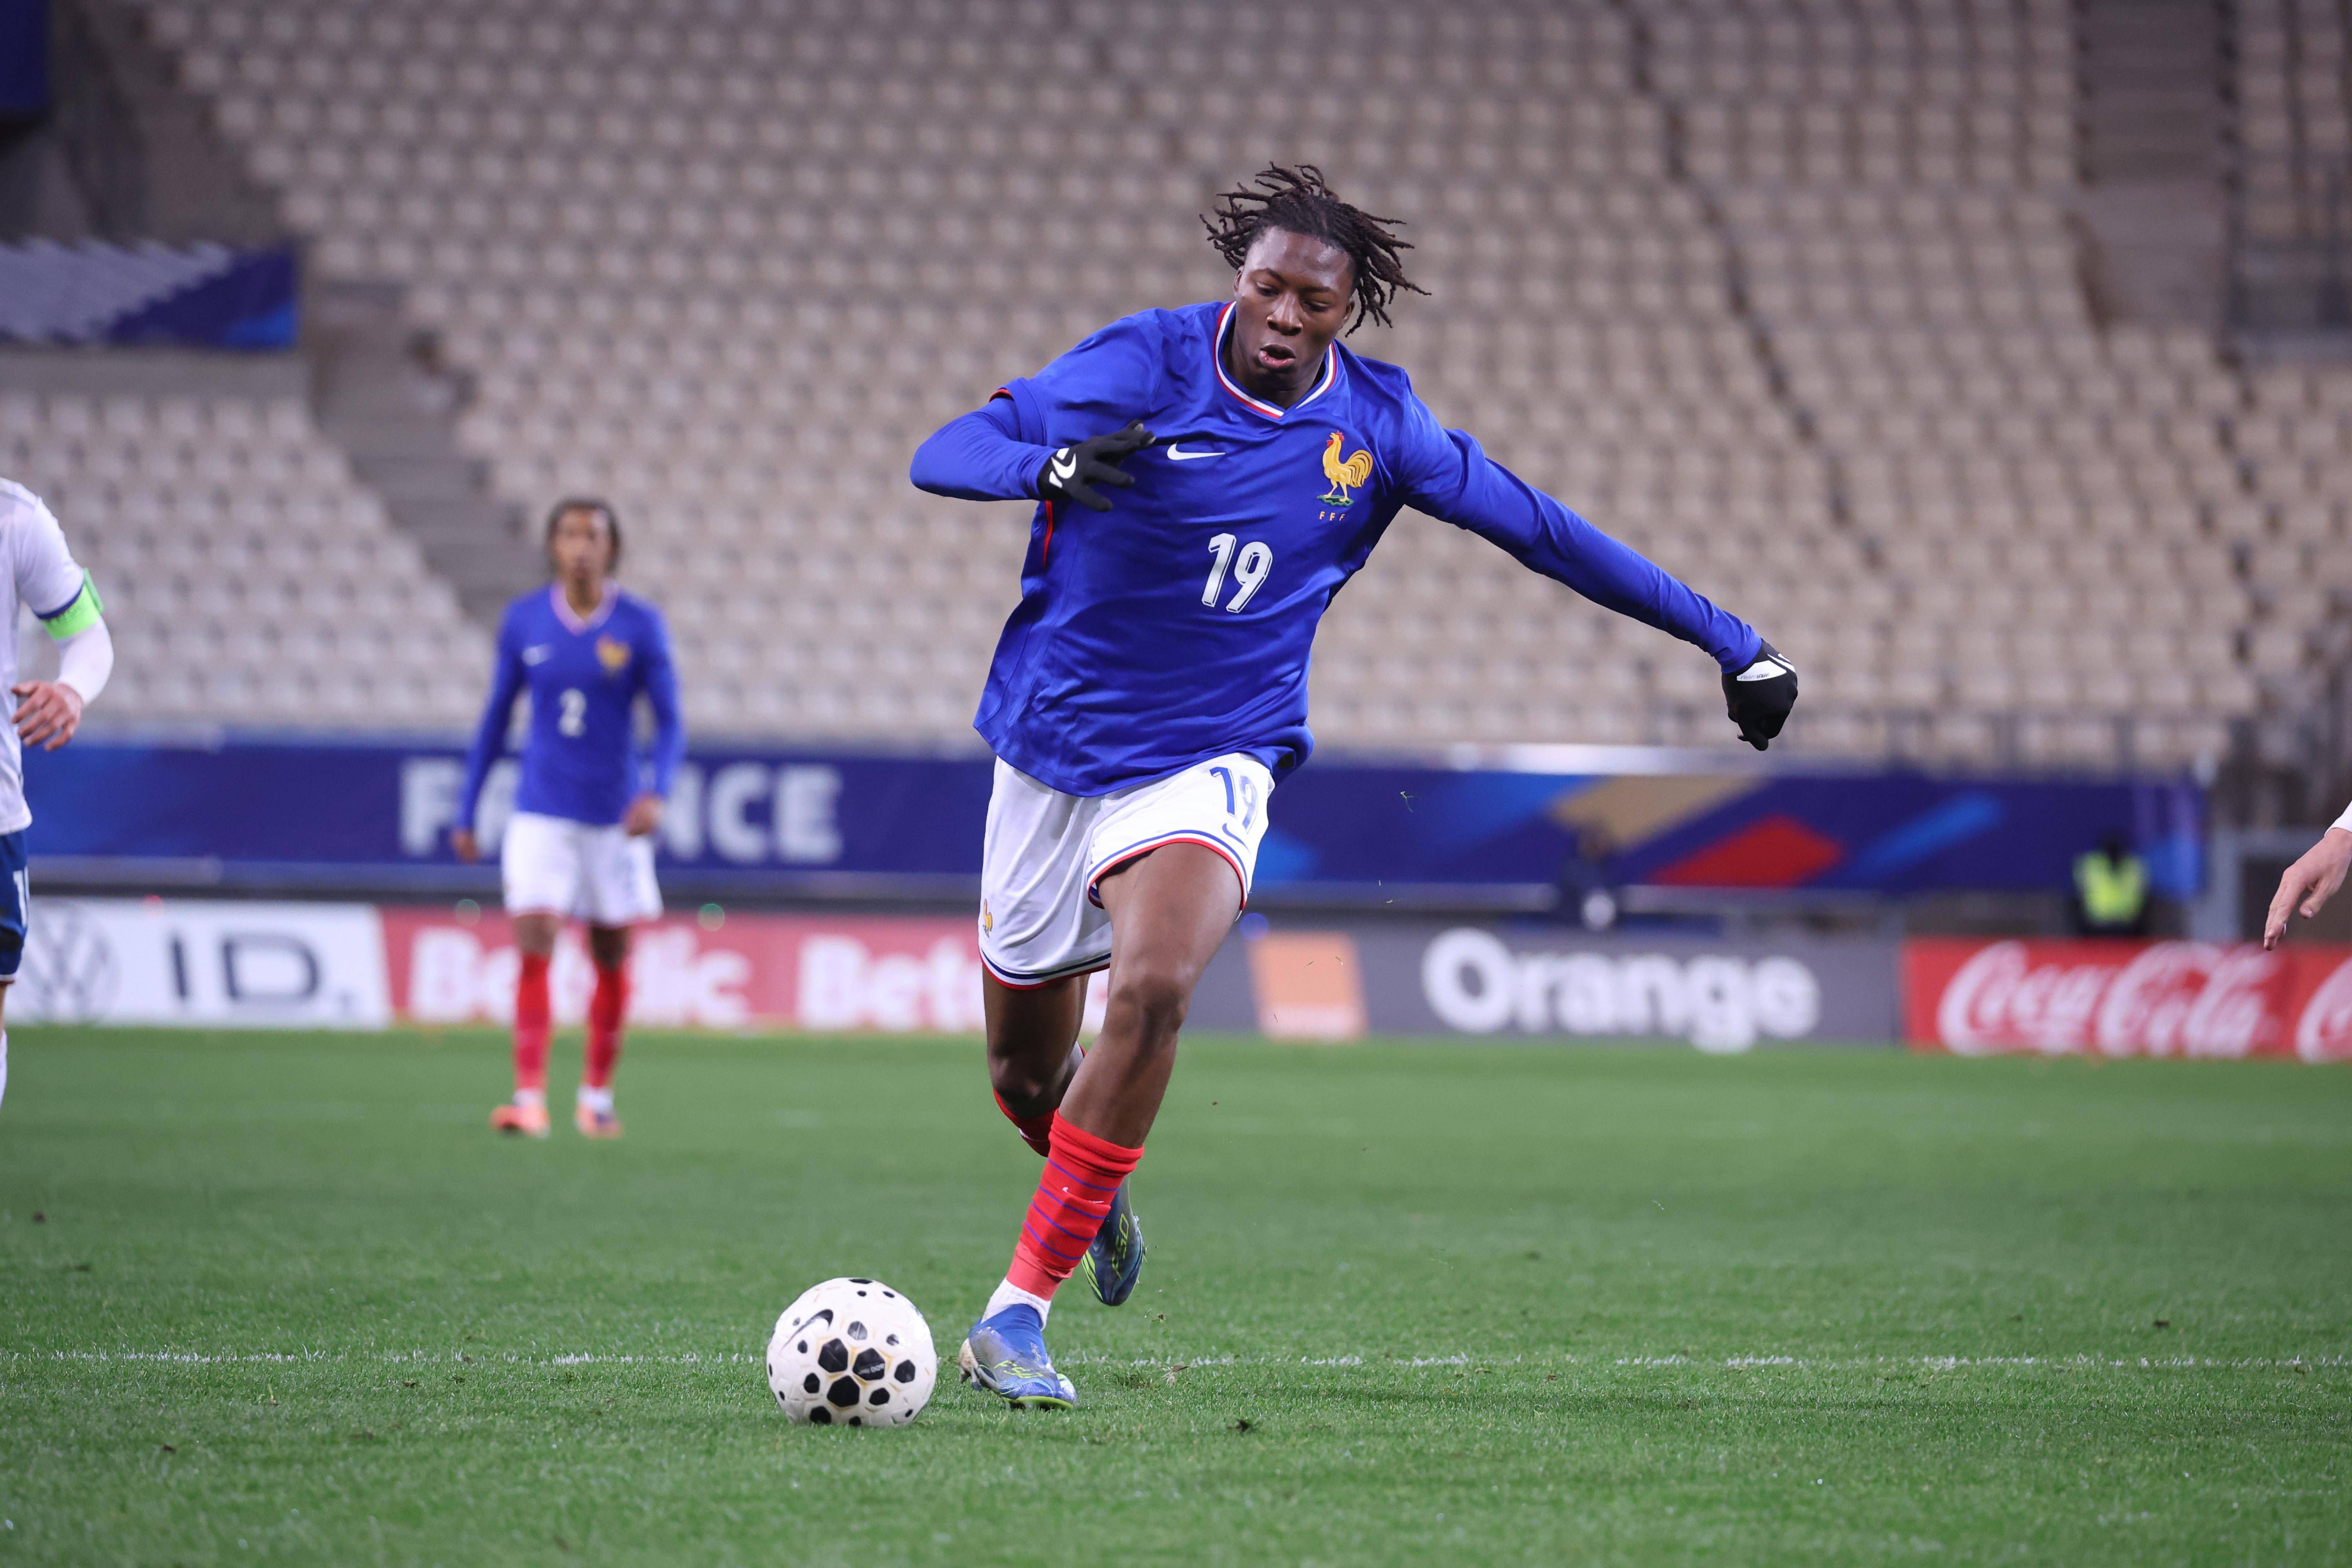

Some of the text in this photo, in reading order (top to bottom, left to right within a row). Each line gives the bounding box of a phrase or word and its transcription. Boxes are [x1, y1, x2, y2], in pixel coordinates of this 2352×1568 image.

[1201, 533, 1273, 613] 19
[559, 687, 586, 737] 2
[401, 757, 844, 860] FNCE
[1209, 766, 1258, 834] 19
[1422, 928, 1820, 1053] Orange
